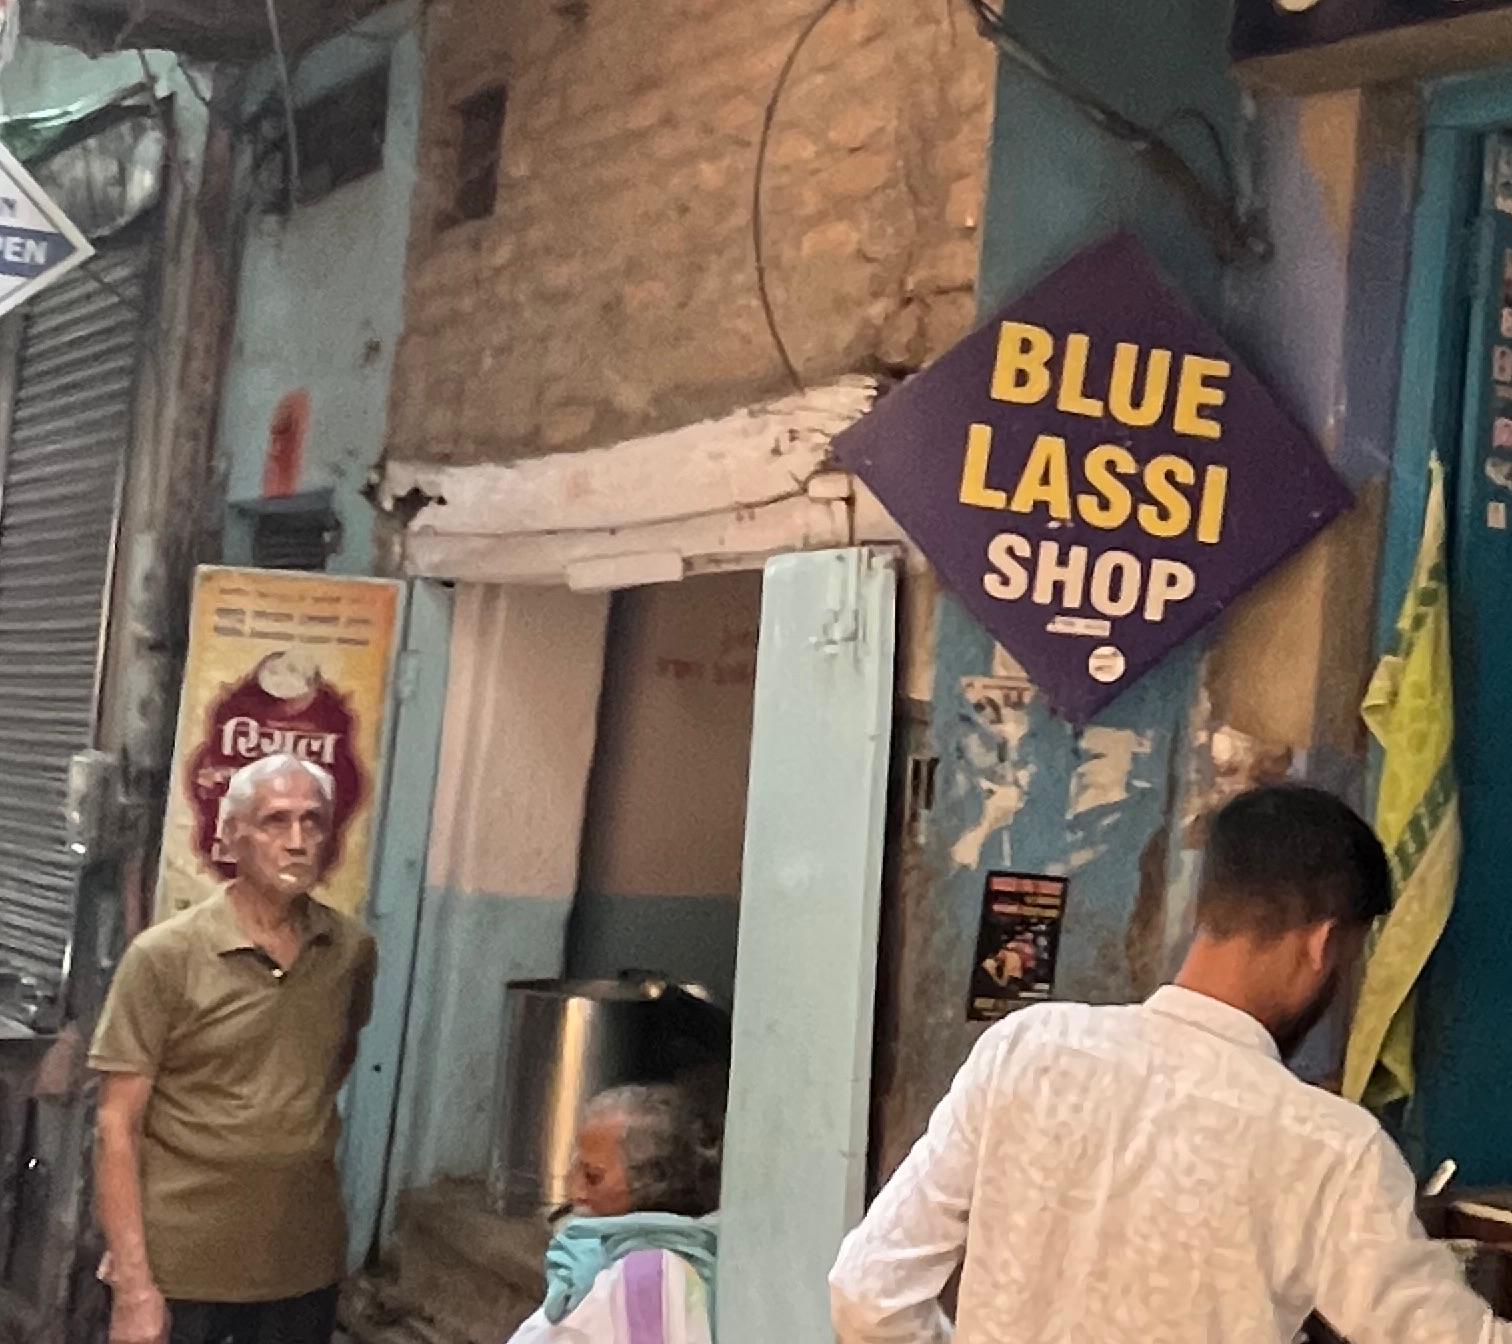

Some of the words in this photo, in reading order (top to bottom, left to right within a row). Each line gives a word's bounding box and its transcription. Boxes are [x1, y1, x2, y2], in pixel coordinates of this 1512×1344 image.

[991, 320, 1231, 439] BLUE
[958, 423, 1228, 544] LASSI
[982, 532, 1196, 622] SHOP
